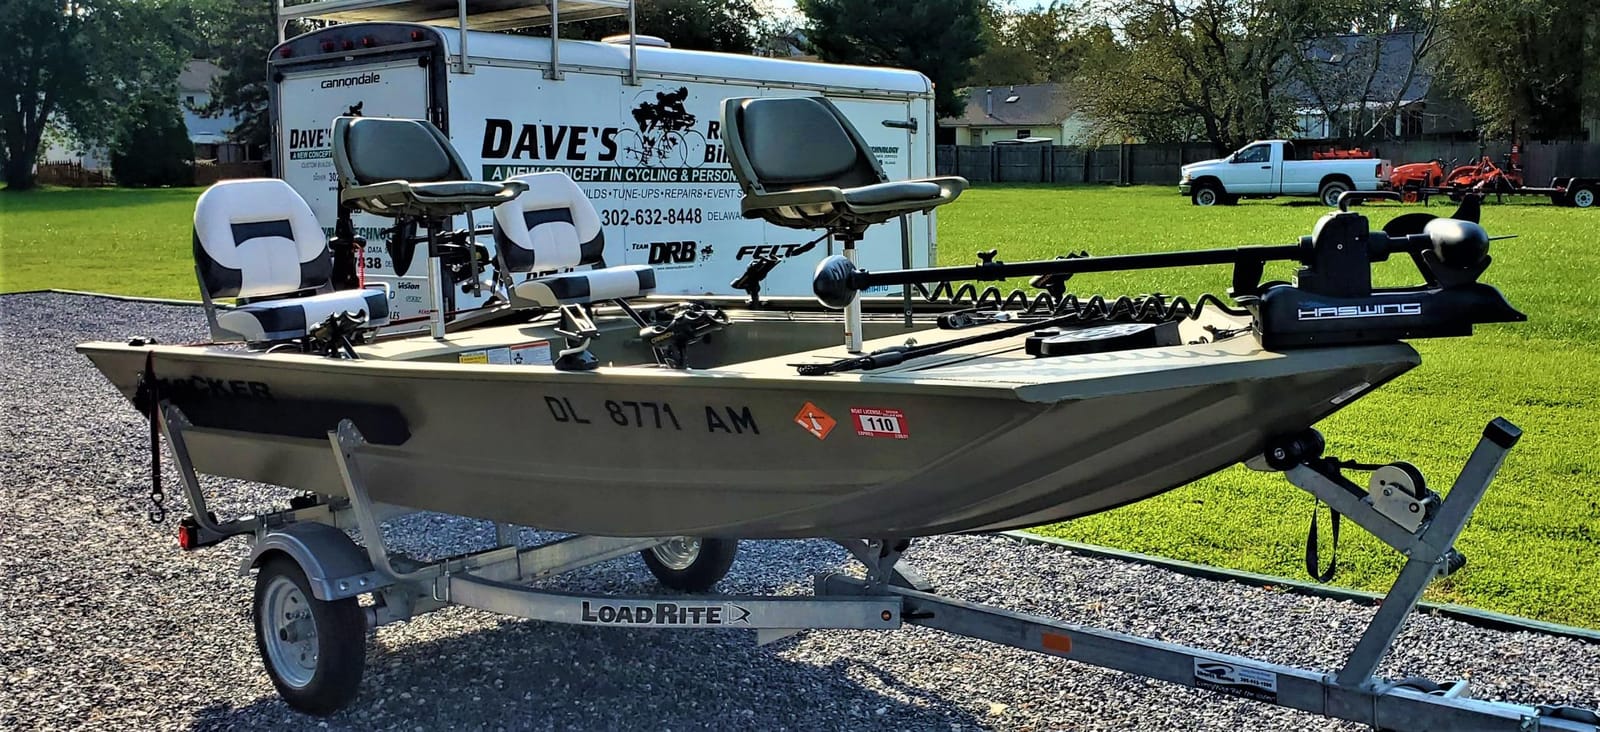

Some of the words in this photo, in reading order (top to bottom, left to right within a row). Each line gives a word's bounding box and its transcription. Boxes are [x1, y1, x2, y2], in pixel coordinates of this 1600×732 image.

[320, 72, 381, 89] cannondale
[481, 118, 620, 162] DAVE'S
[309, 150, 332, 158] CONCEPT
[491, 167, 504, 180] A
[610, 168, 621, 181] IN
[625, 169, 678, 182] CYCLING
[680, 170, 689, 182] &
[692, 170, 738, 182] PERSON
[664, 189, 703, 199] REPAIRS
[707, 190, 735, 199] EVENT
[601, 208, 702, 226] 302-632-8448
[707, 211, 741, 221] DELAWA
[647, 240, 697, 265] DRB
[735, 243, 802, 262] FELT
[1298, 303, 1422, 320] HASWING
[543, 396, 592, 425] DL
[604, 400, 683, 431] 8771
[704, 405, 760, 435] AM
[866, 417, 894, 431] 110
